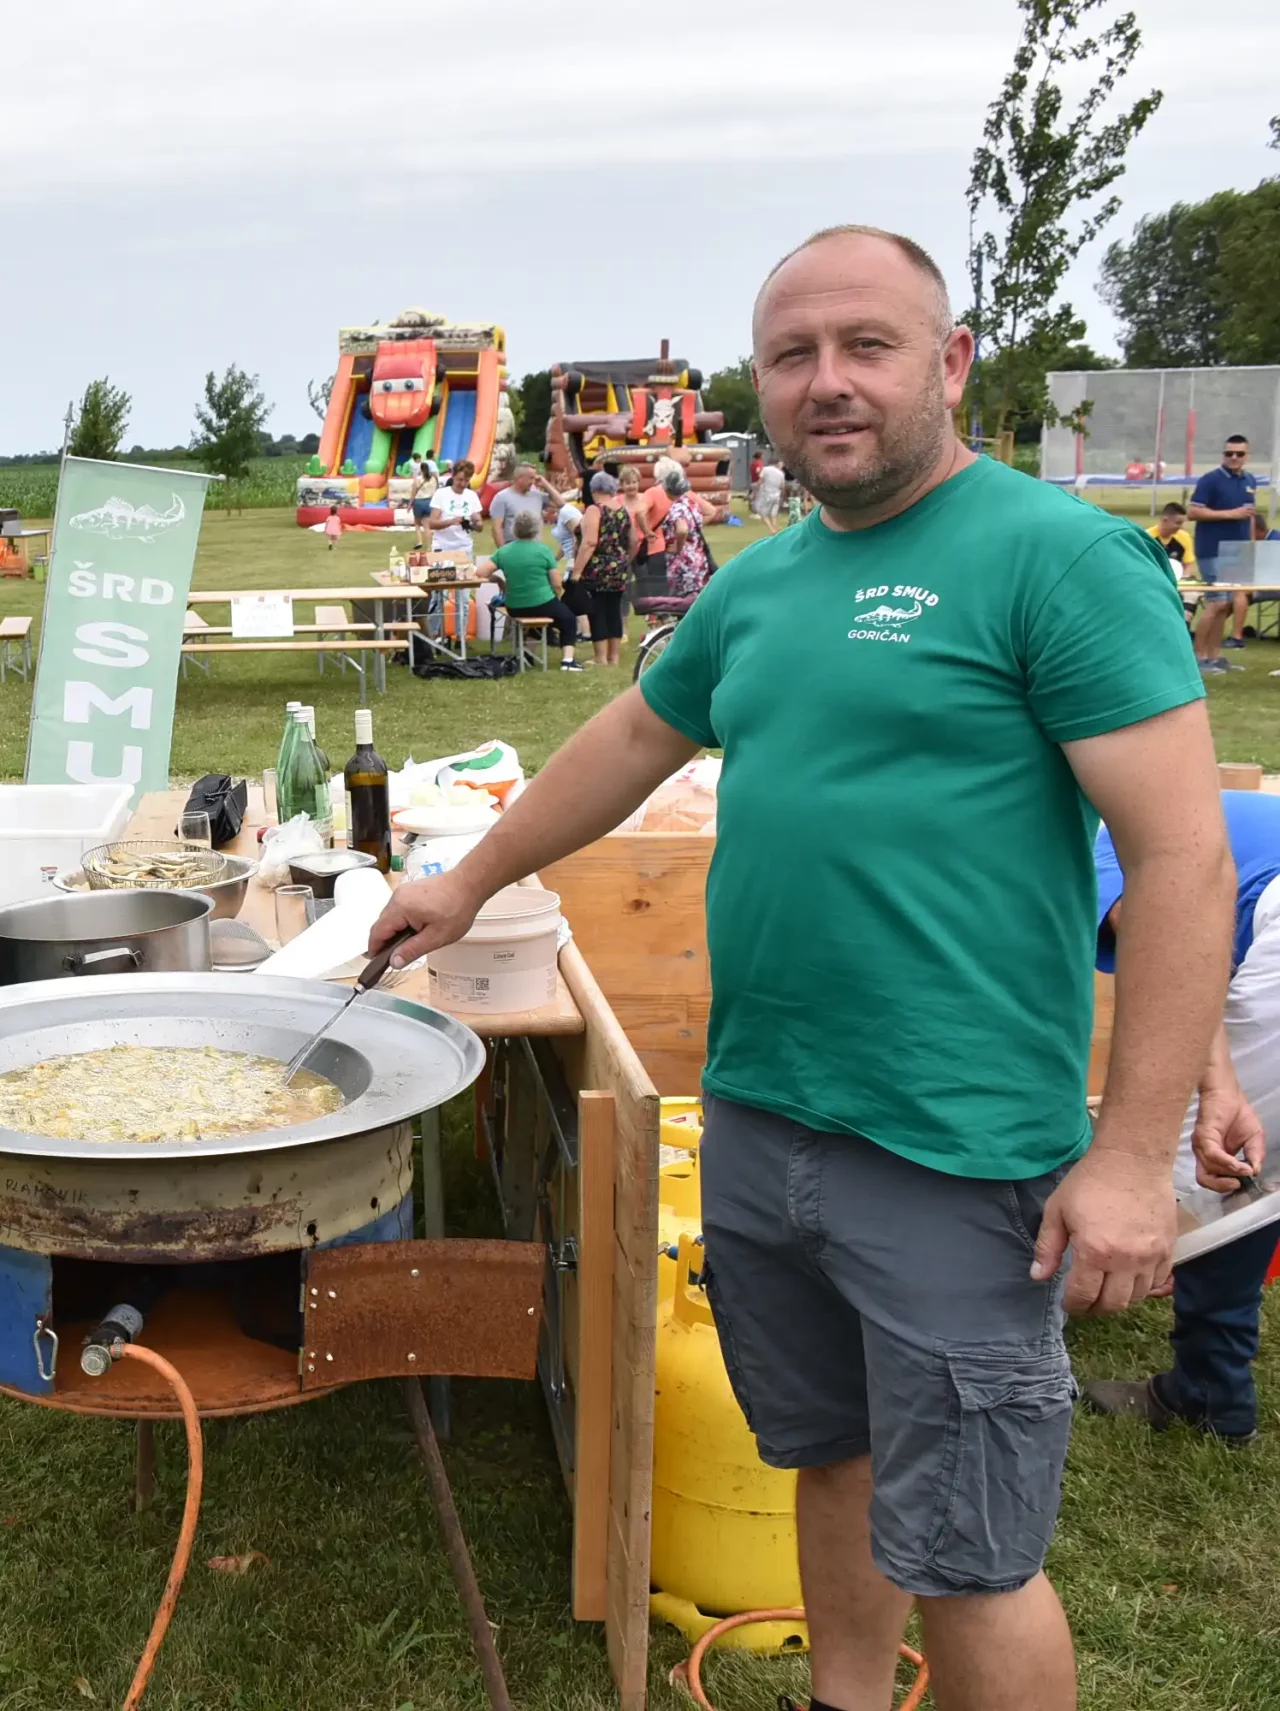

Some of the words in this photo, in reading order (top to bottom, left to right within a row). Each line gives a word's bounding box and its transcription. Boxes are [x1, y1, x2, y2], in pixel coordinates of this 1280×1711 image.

[68, 560, 174, 605] ŠRD
[854, 585, 889, 603] ŠRD
[847, 629, 911, 643] GORIČAN
